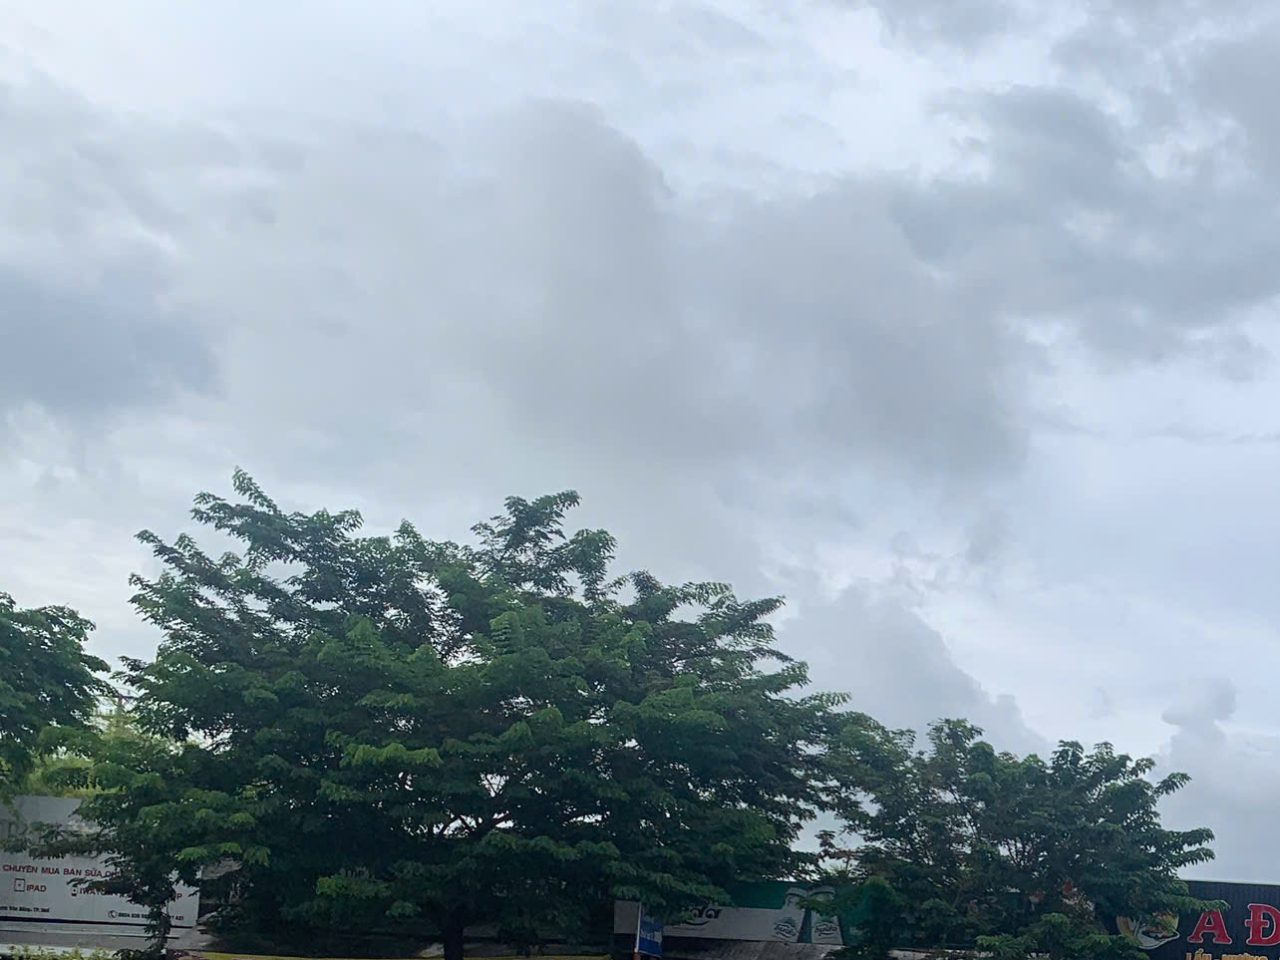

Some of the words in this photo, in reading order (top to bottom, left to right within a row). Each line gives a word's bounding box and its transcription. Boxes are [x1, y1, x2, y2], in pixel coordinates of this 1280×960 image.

[41, 867, 60, 875] MUA
[26, 884, 47, 893] IPAD
[1187, 909, 1232, 945] A
